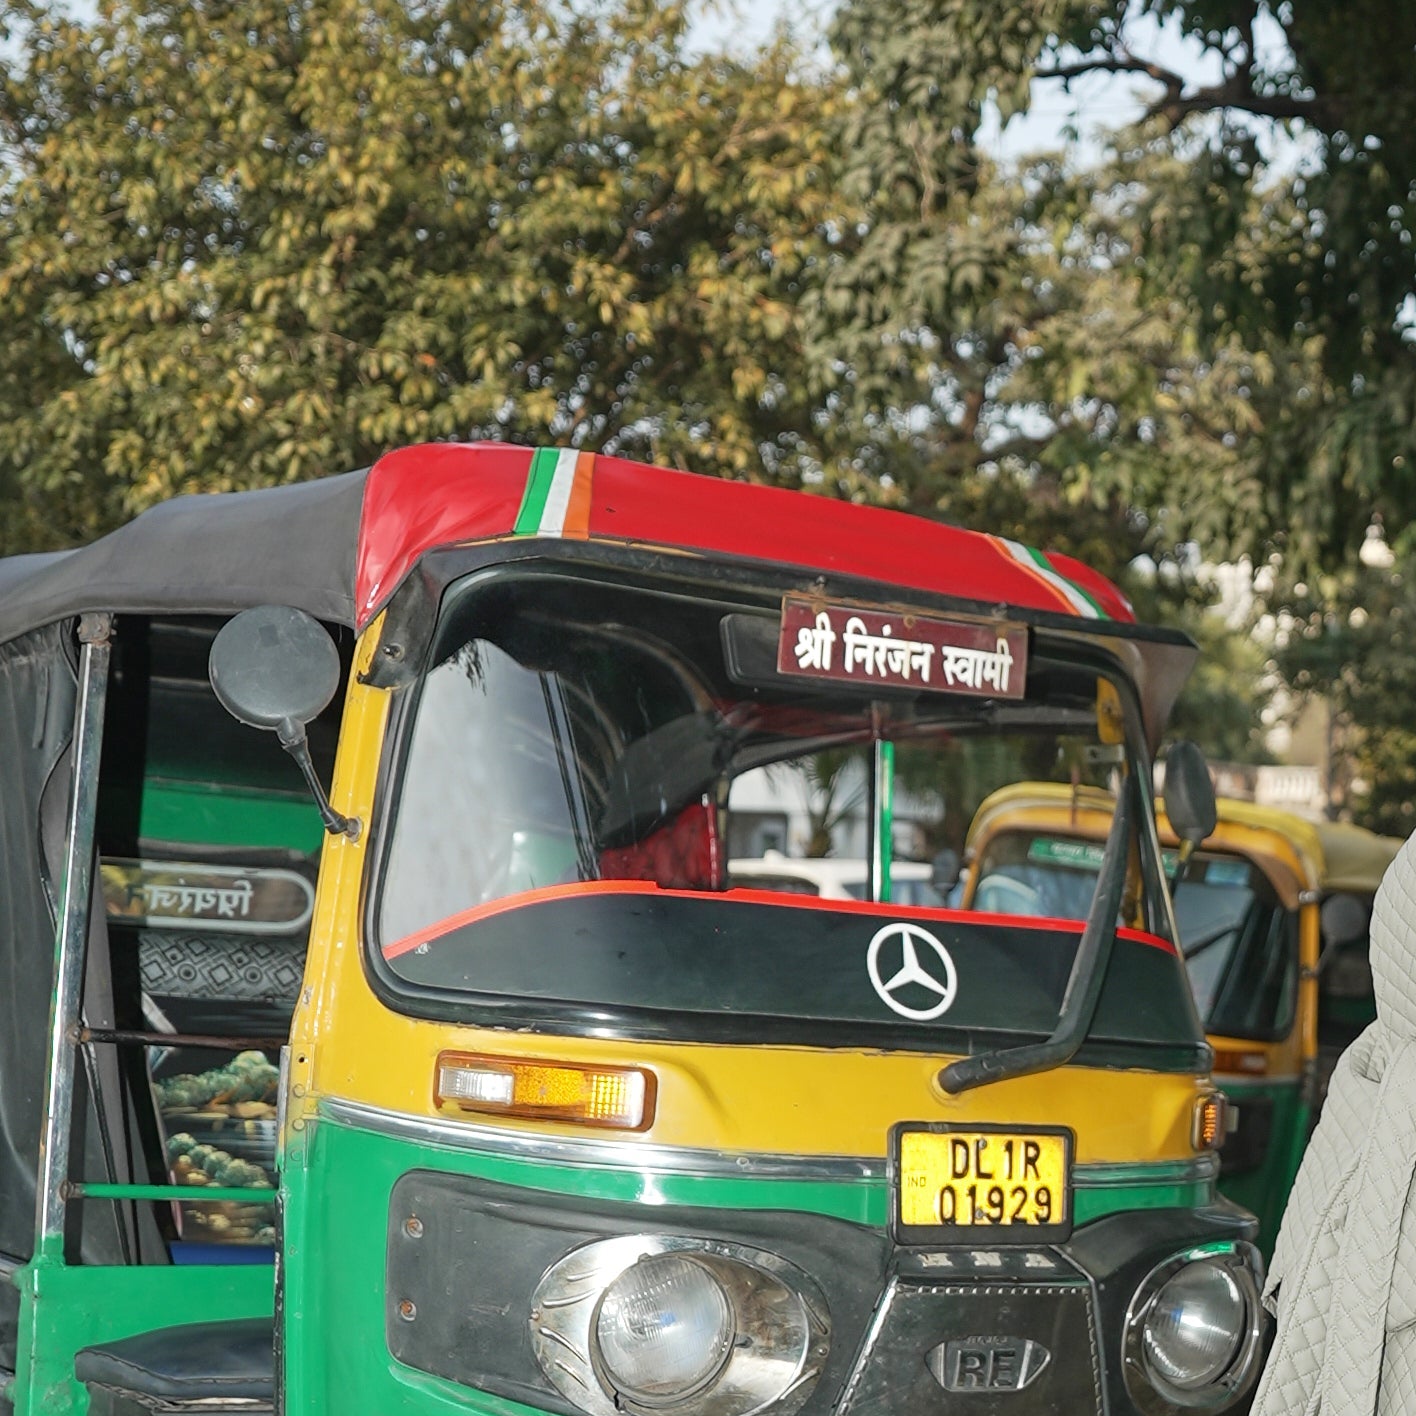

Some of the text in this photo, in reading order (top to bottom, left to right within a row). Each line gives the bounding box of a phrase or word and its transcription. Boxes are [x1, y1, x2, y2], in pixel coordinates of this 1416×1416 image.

[794, 611, 1013, 692] श्री निरंजन स्वामी
[907, 1175, 927, 1188] IND
[938, 1184, 1052, 1226] 01929
[953, 1348, 1016, 1388] RE
